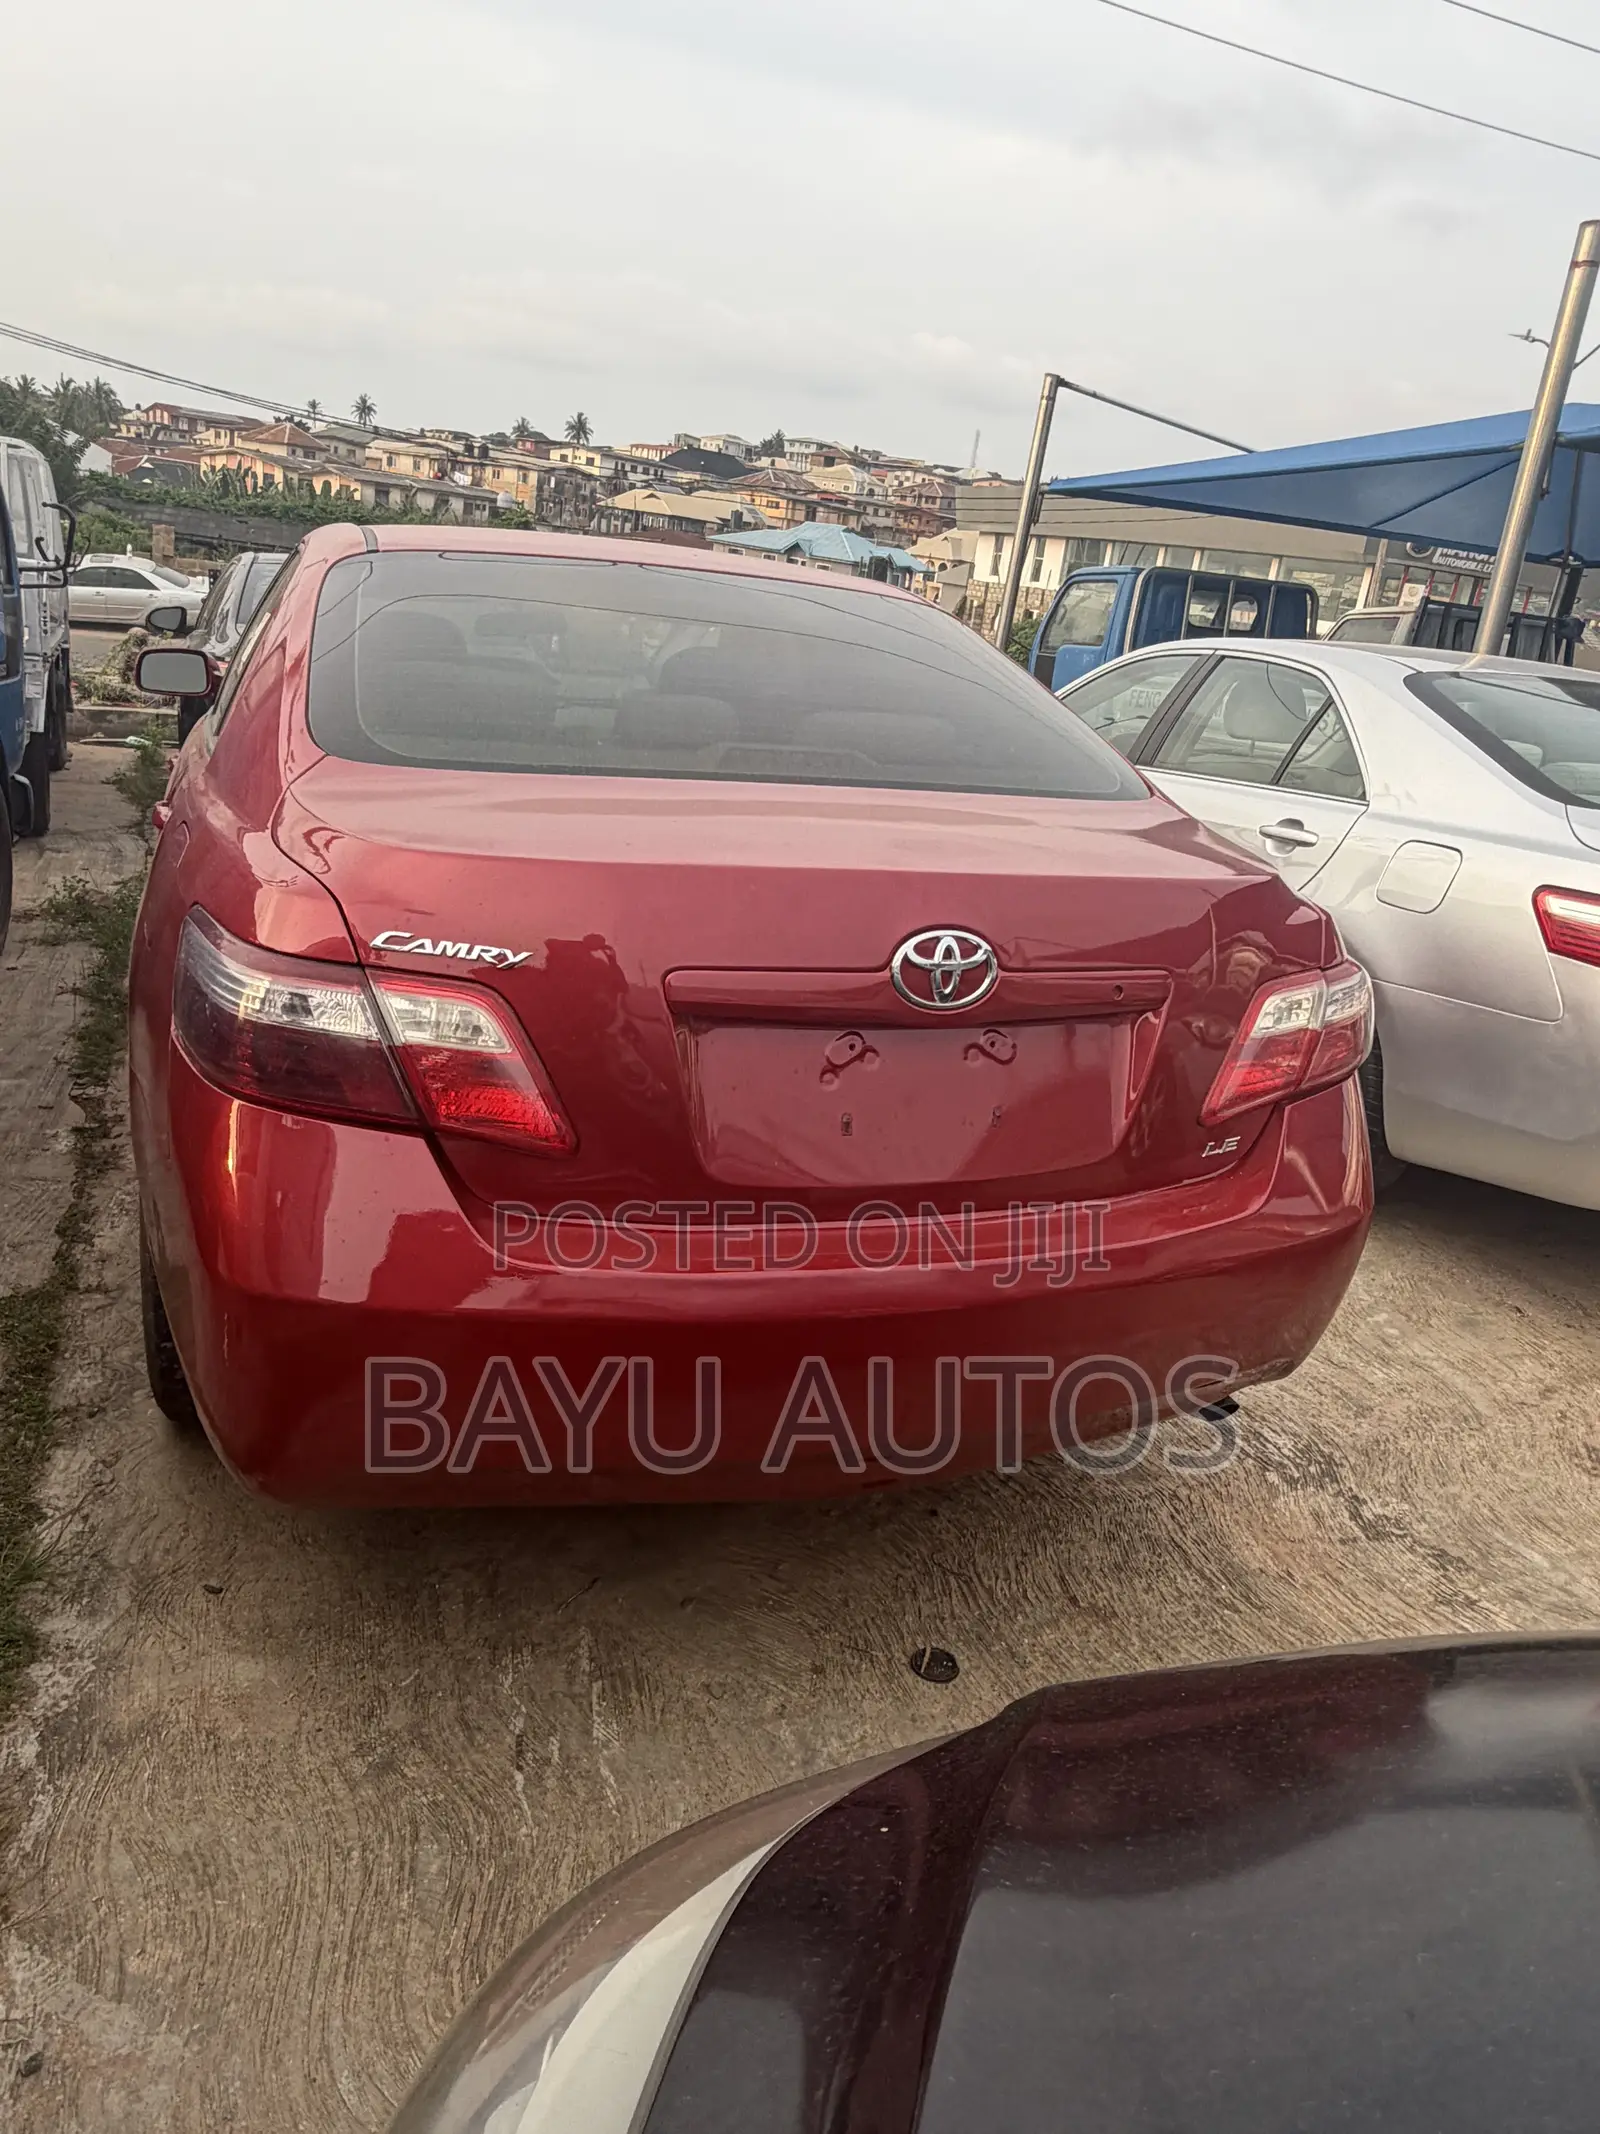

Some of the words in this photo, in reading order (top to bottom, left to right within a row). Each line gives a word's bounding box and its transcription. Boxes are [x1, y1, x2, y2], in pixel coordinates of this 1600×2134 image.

[1437, 555, 1484, 573] AUTOMOBILE
[370, 931, 534, 969] CAMRY
[1201, 1136, 1241, 1158] LE
